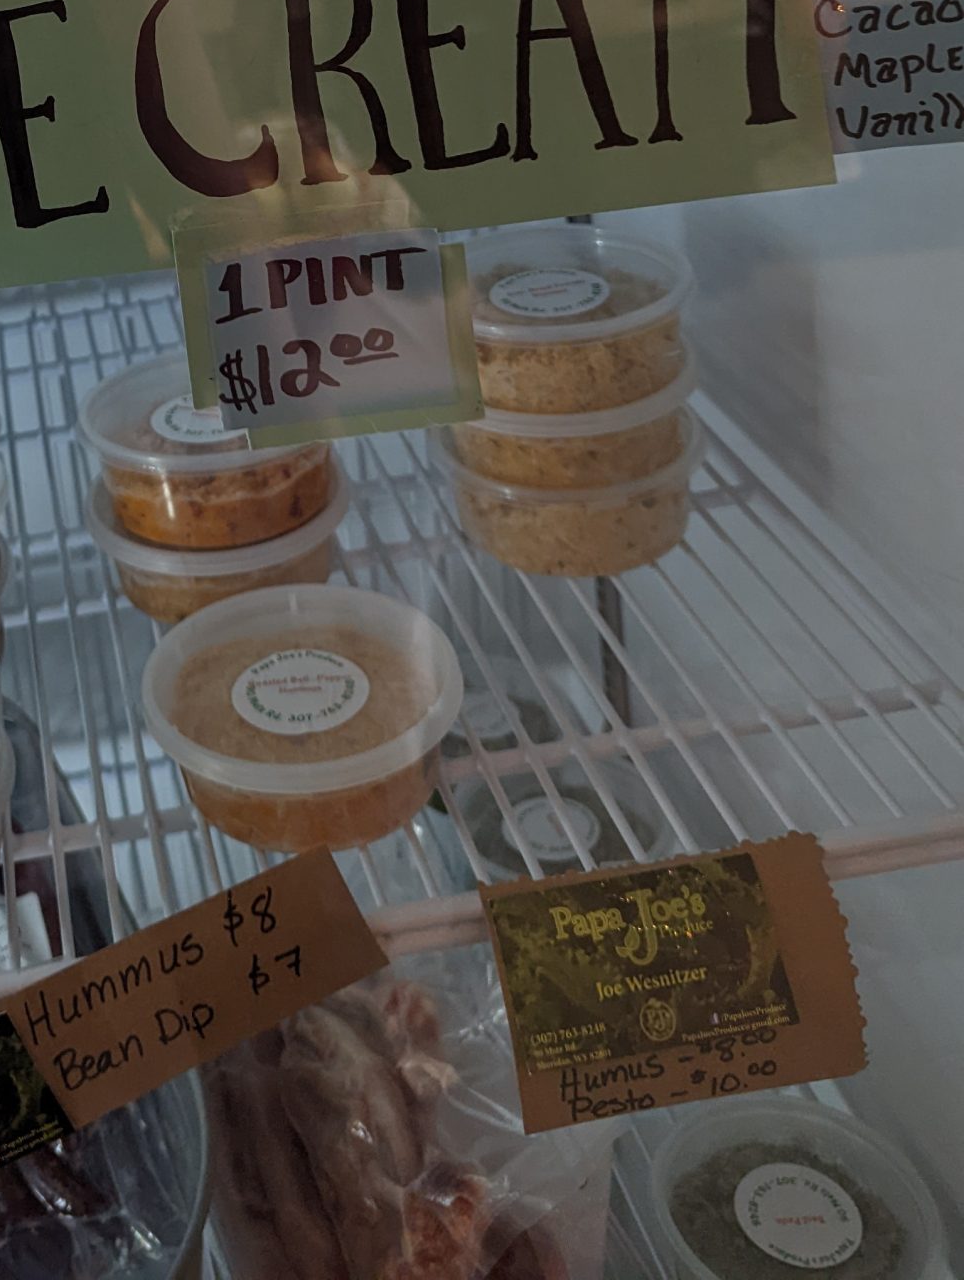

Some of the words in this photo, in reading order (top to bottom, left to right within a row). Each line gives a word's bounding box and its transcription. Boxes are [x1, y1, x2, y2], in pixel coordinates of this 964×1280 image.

[215, 262, 264, 324] 1
[265, 247, 428, 309] PINT
[549, 903, 628, 942] Papa
[615, 884, 707, 966] Joe's
[658, 917, 714, 939] Produce
[24, 933, 204, 1045] Hummus
[222, 886, 277, 946] $8
[595, 979, 624, 1003] Joe
[625, 965, 709, 994] Wesnitzer
[54, 1034, 143, 1091] Bean
[155, 1000, 214, 1046] Dip
[248, 946, 301, 995] $7
[560, 1055, 667, 1102] Humus
[568, 1089, 656, 1121] Pesto
